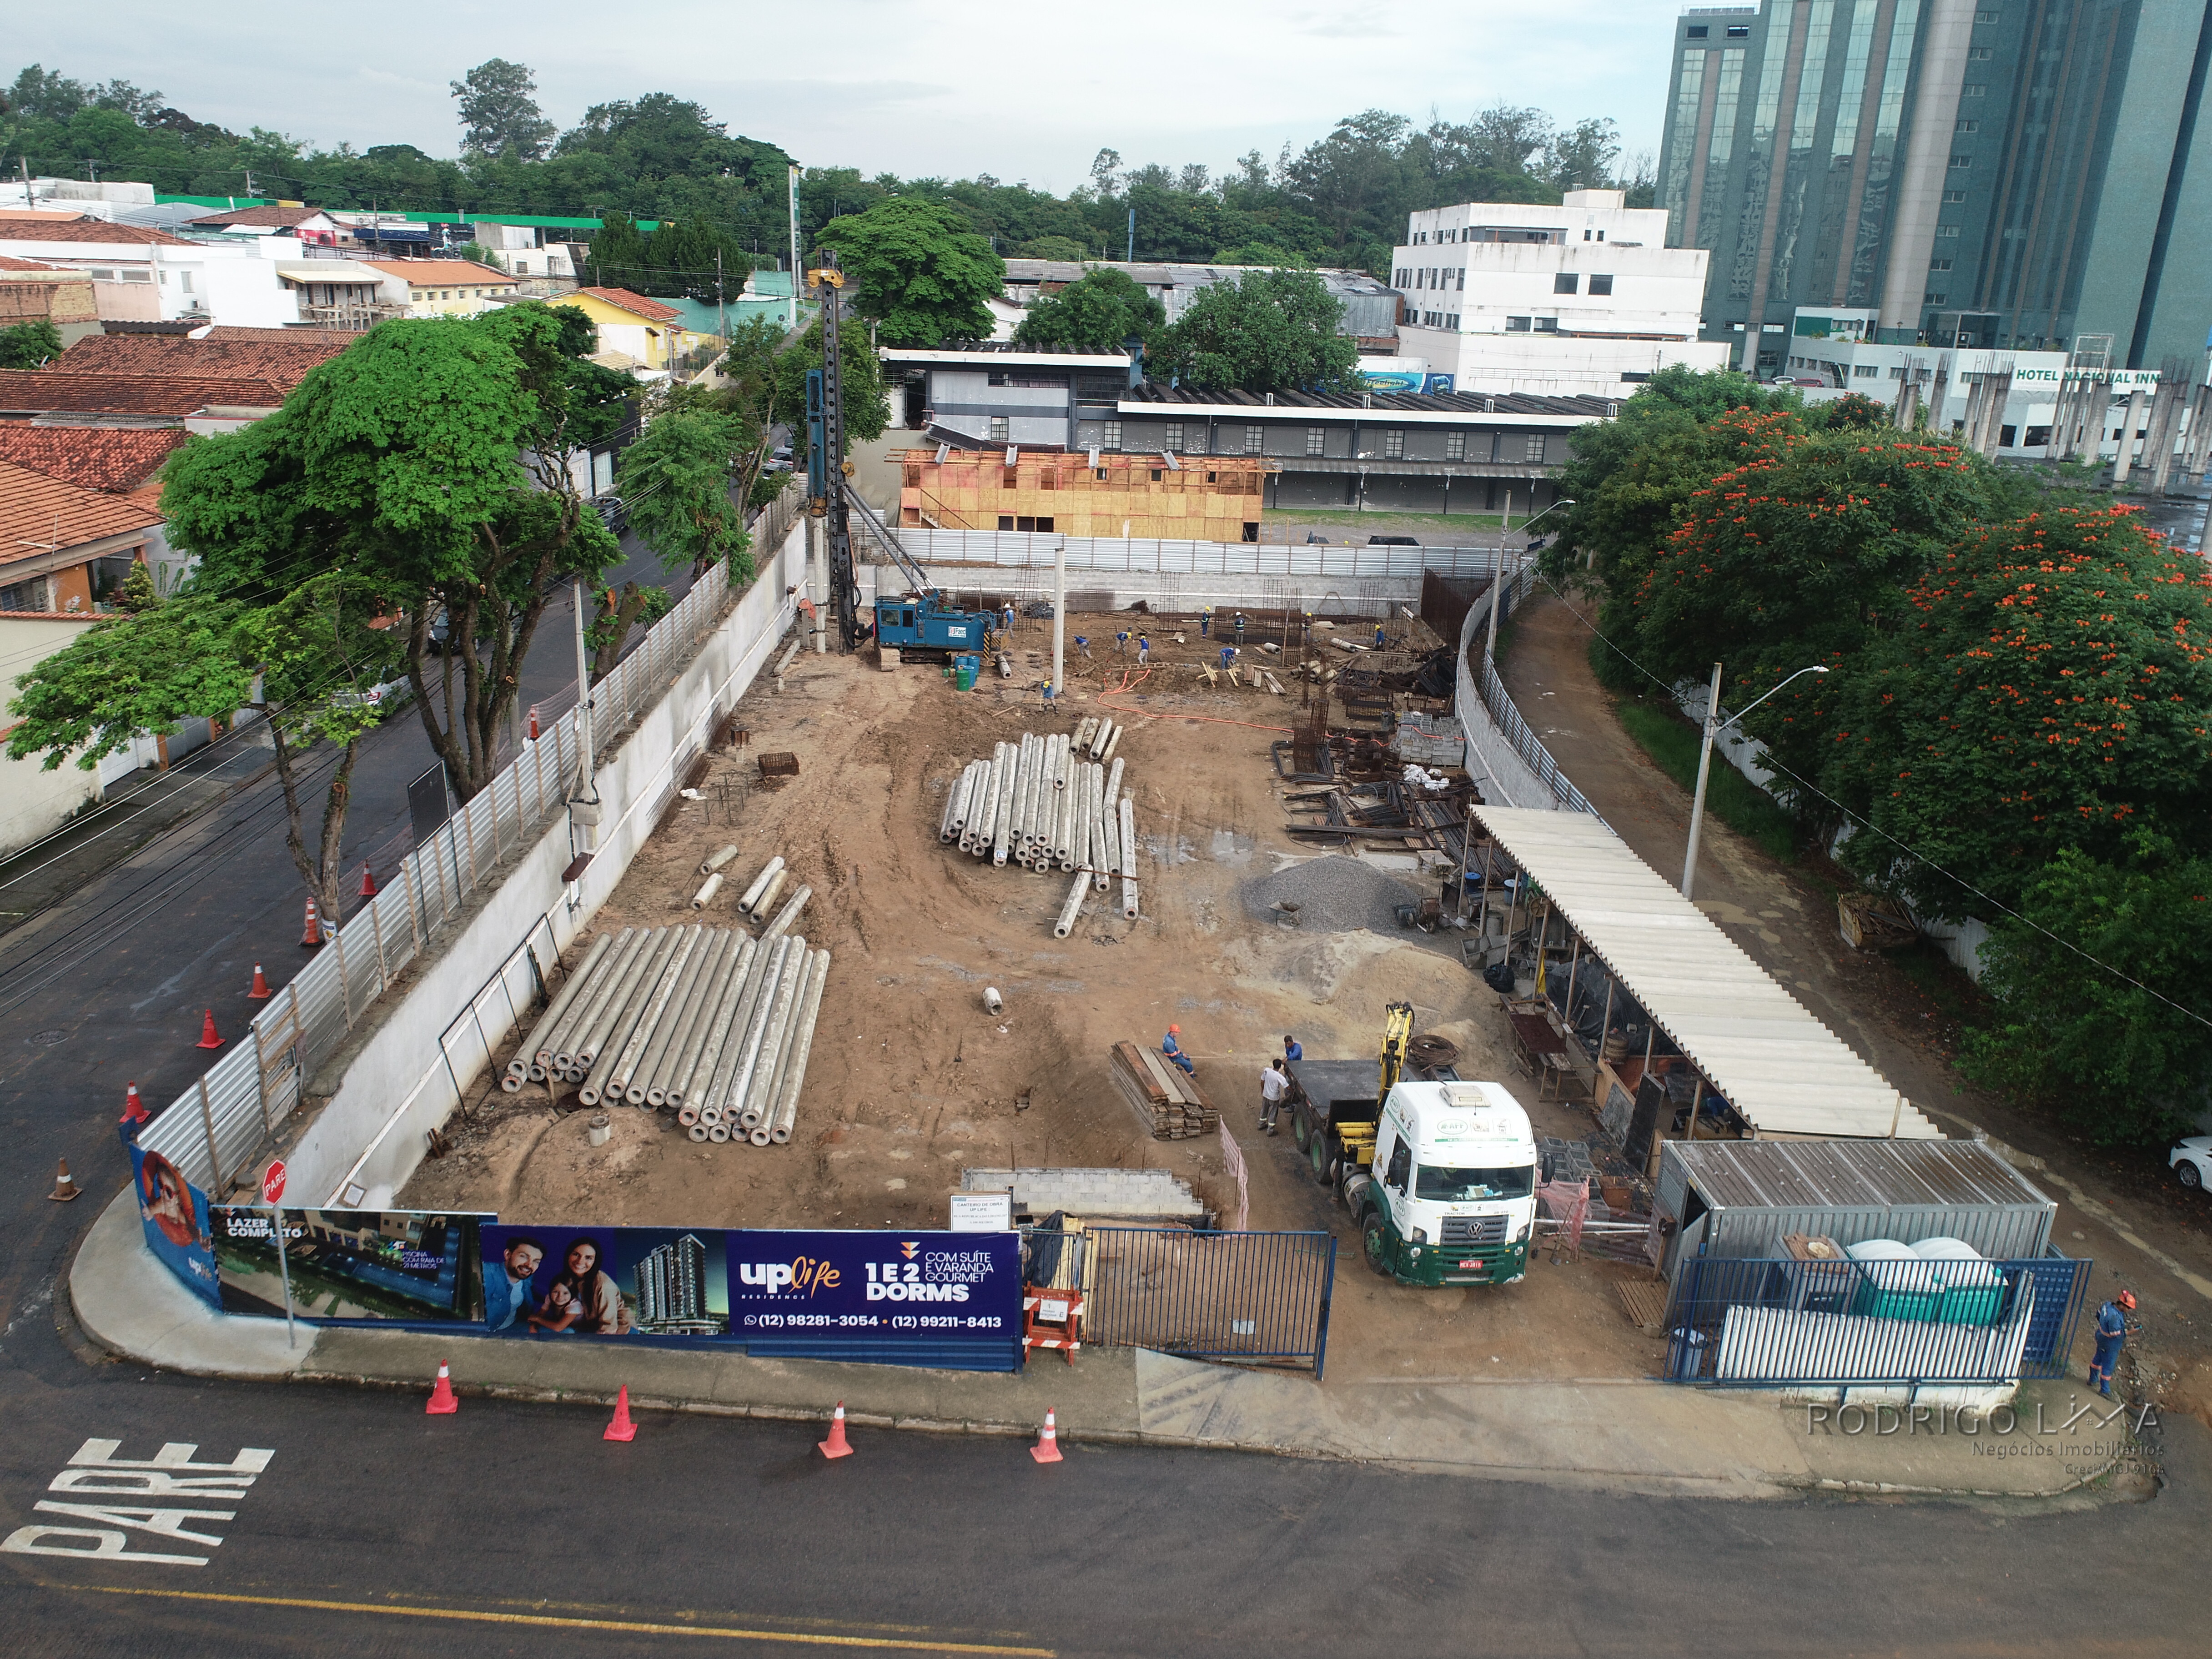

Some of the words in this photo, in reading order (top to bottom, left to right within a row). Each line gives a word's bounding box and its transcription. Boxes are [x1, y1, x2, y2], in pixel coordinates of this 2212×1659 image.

[2016, 369, 2058, 381] HOTEL
[2135, 373, 2160, 383] INN
[265, 1169, 286, 1197] PARE
[226, 1218, 269, 1228] LAZER
[925, 1252, 957, 1262] COM
[960, 1250, 991, 1263] SUÍTE
[925, 1262, 932, 1272] E
[934, 1262, 994, 1272] VARANDA
[925, 1272, 986, 1282] GOURMET
[866, 1282, 970, 1302] DORMS
[759, 1314, 784, 1327] (12)
[786, 1315, 879, 1327] 98281-3054
[892, 1315, 917, 1328] (12)
[920, 1316, 1002, 1328] 99211-8413
[1, 1438, 276, 1566] PARE
